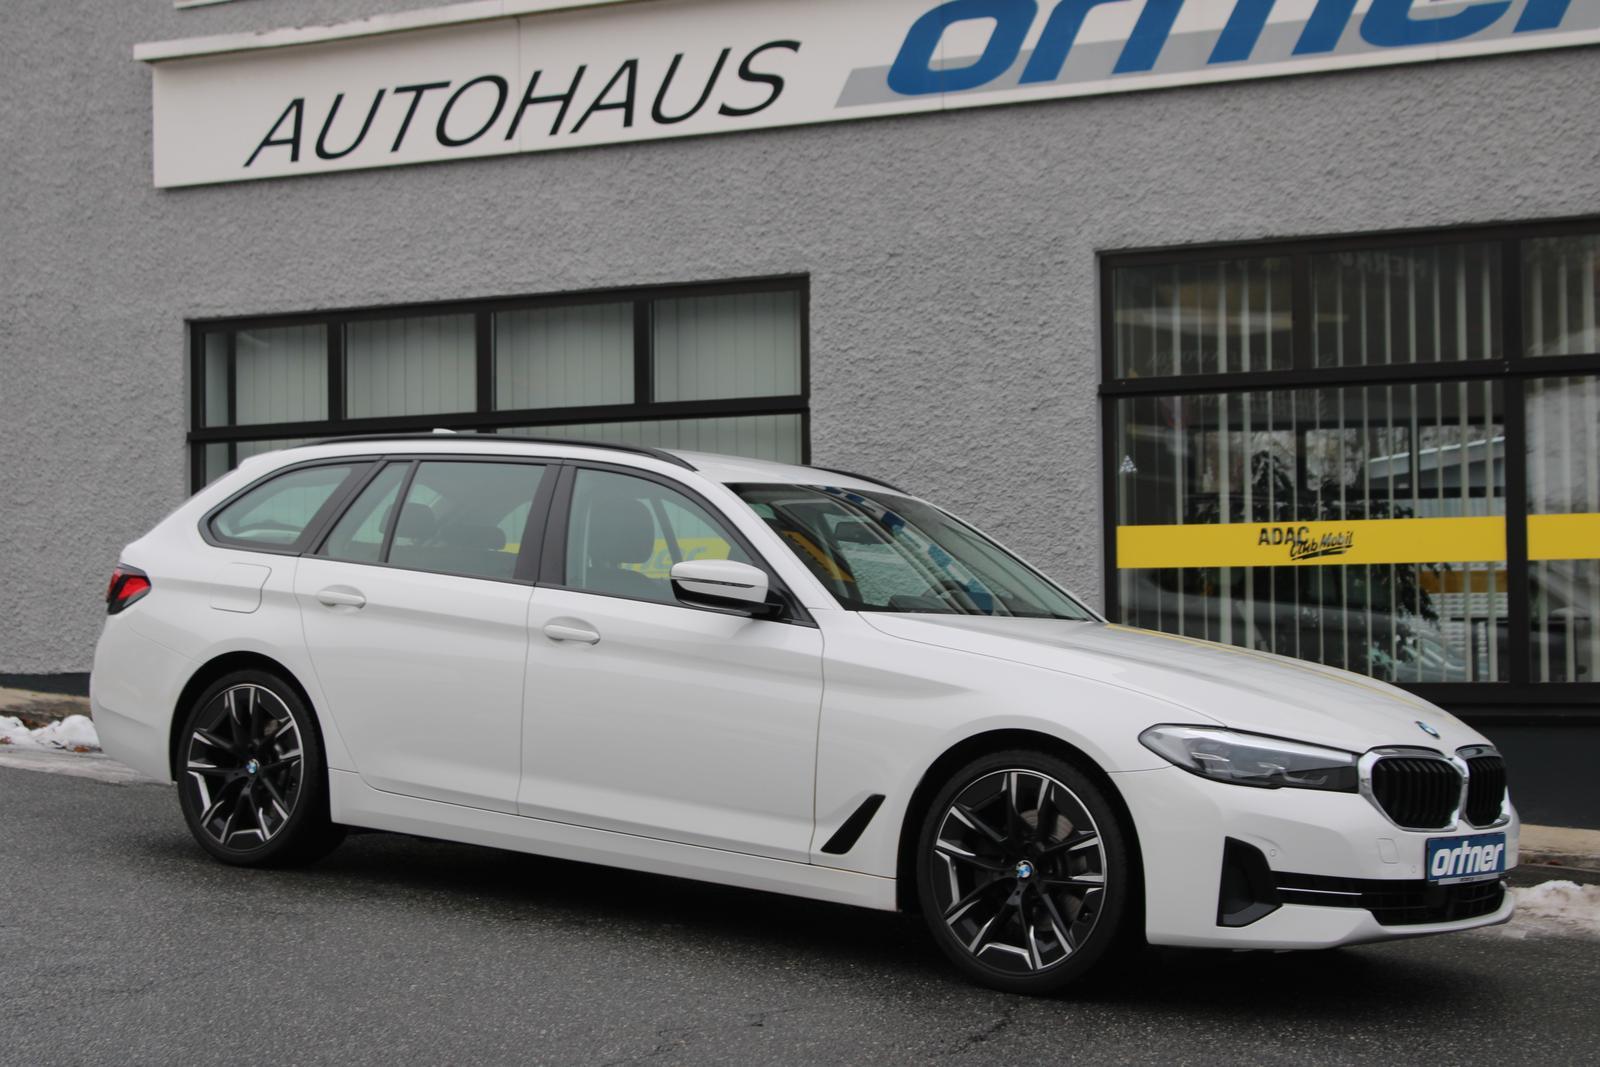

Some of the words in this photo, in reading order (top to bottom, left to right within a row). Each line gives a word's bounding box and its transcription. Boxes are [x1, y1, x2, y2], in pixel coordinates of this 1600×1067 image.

[243, 40, 802, 168] AUTOHAUS
[1258, 526, 1310, 546] ADAC
[1431, 840, 1504, 877] ortner
